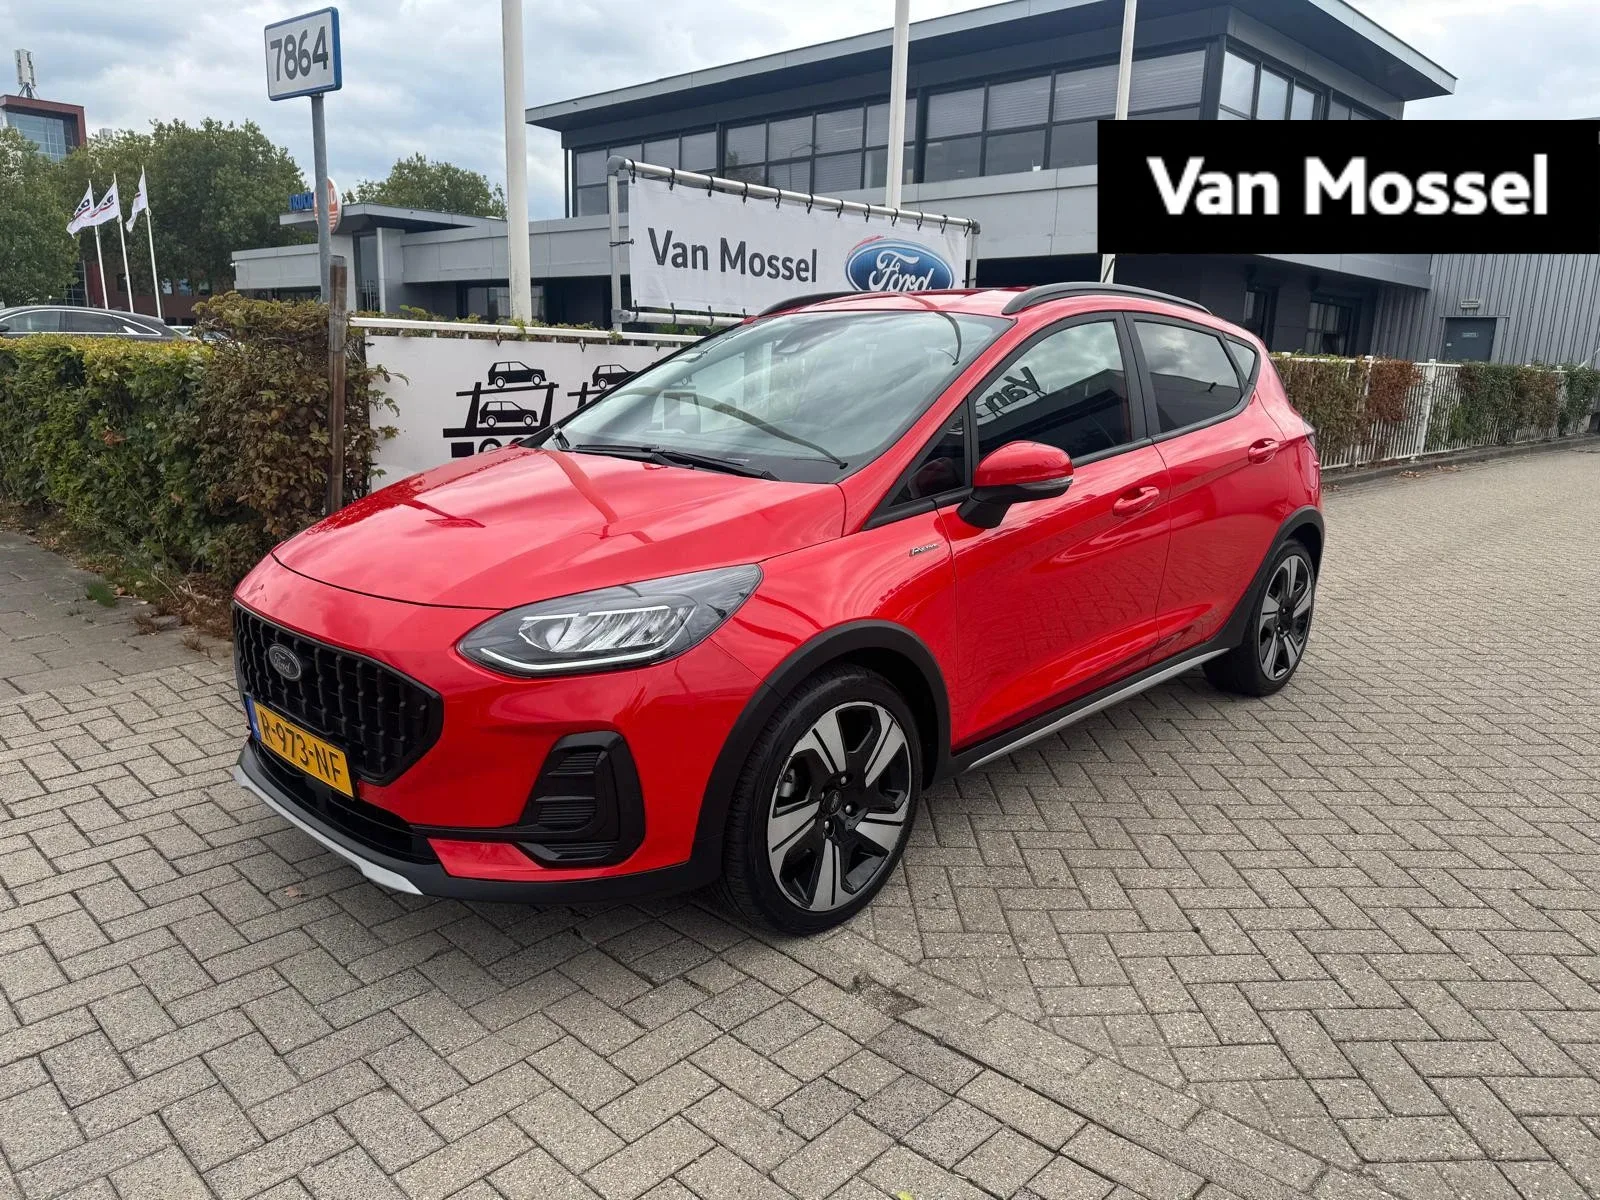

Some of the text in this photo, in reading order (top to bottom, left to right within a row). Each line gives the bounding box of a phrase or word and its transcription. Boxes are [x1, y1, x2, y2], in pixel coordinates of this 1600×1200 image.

[270, 25, 328, 82] 7864
[647, 227, 818, 283] Van Mossel
[868, 250, 935, 291] Ford
[272, 651, 291, 675] Ford
[259, 710, 342, 783] R-973-NF
